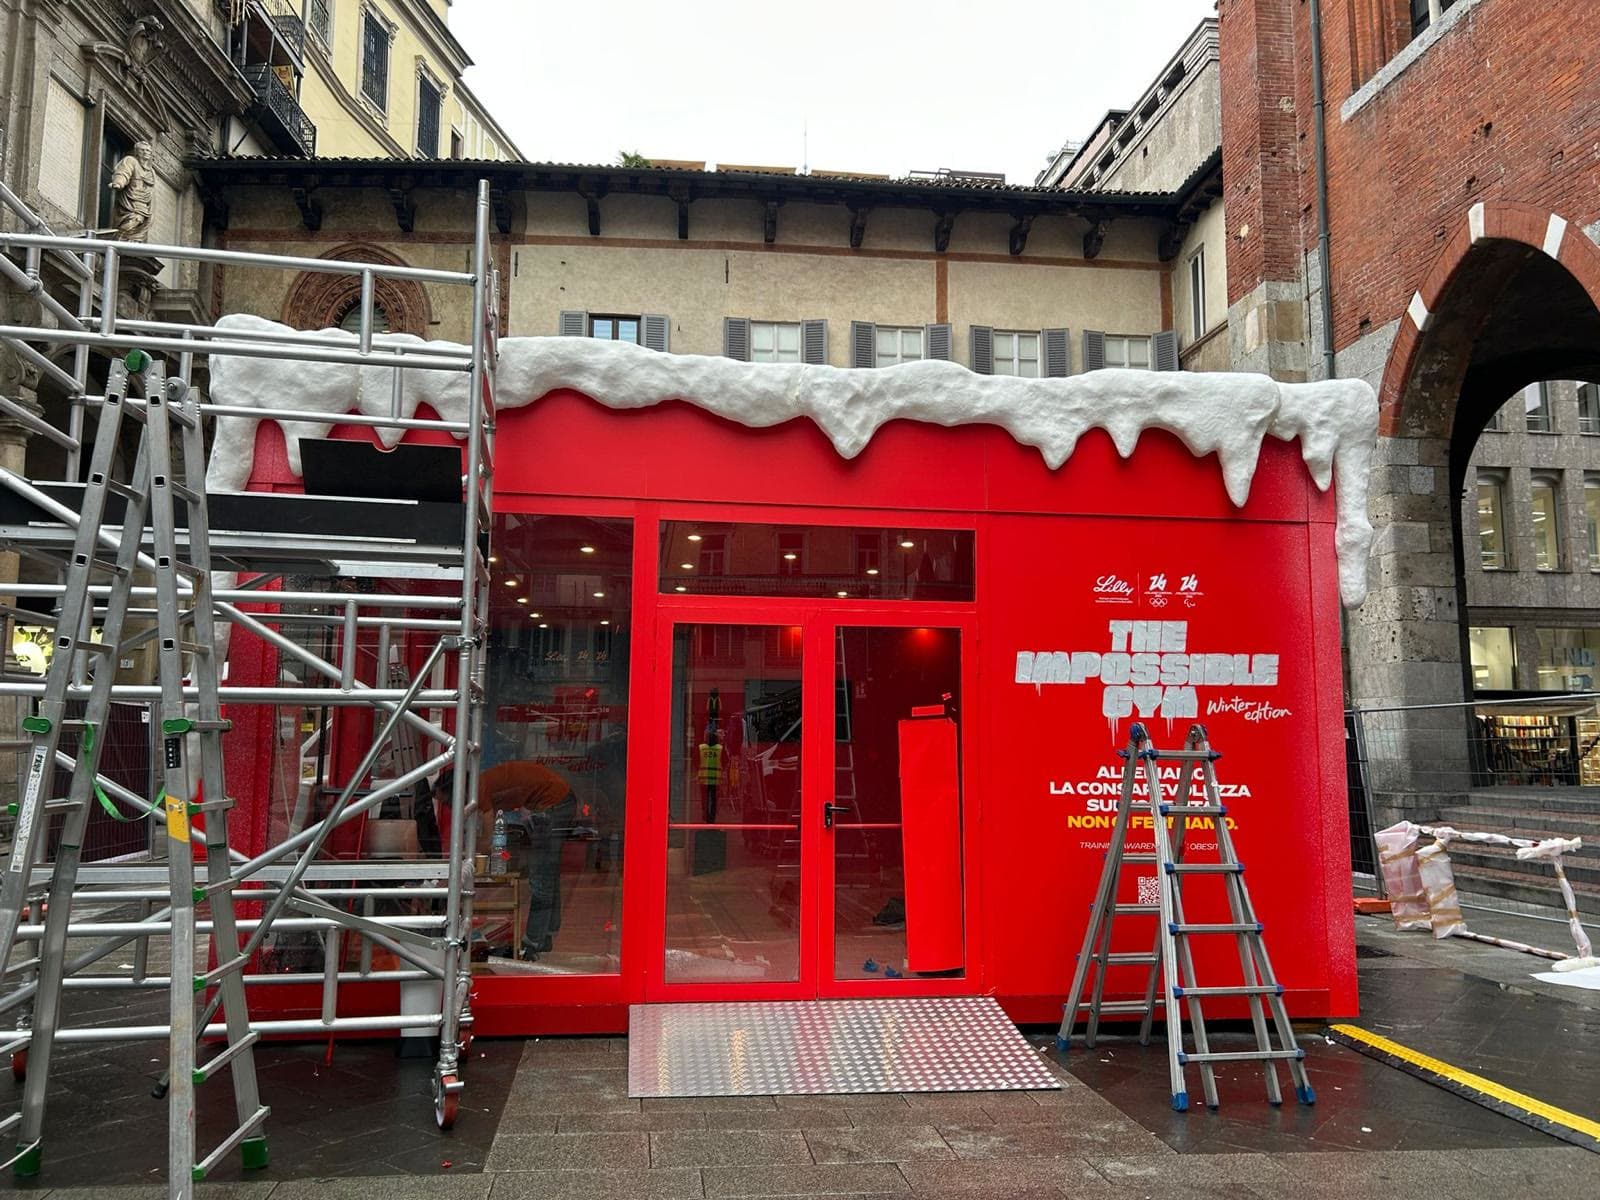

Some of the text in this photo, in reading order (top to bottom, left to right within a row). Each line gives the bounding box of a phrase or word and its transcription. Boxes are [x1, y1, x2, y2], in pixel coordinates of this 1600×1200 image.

[1093, 574, 1135, 597] Lilly
[1109, 619, 1188, 652] THE
[1014, 650, 1280, 687] IMPOSSIBLE
[1102, 685, 1199, 719] GYM
[1206, 695, 1256, 715] Winter
[1244, 701, 1292, 722] edition
[1049, 781, 1074, 795] LA
[1067, 815, 1110, 829] NON
